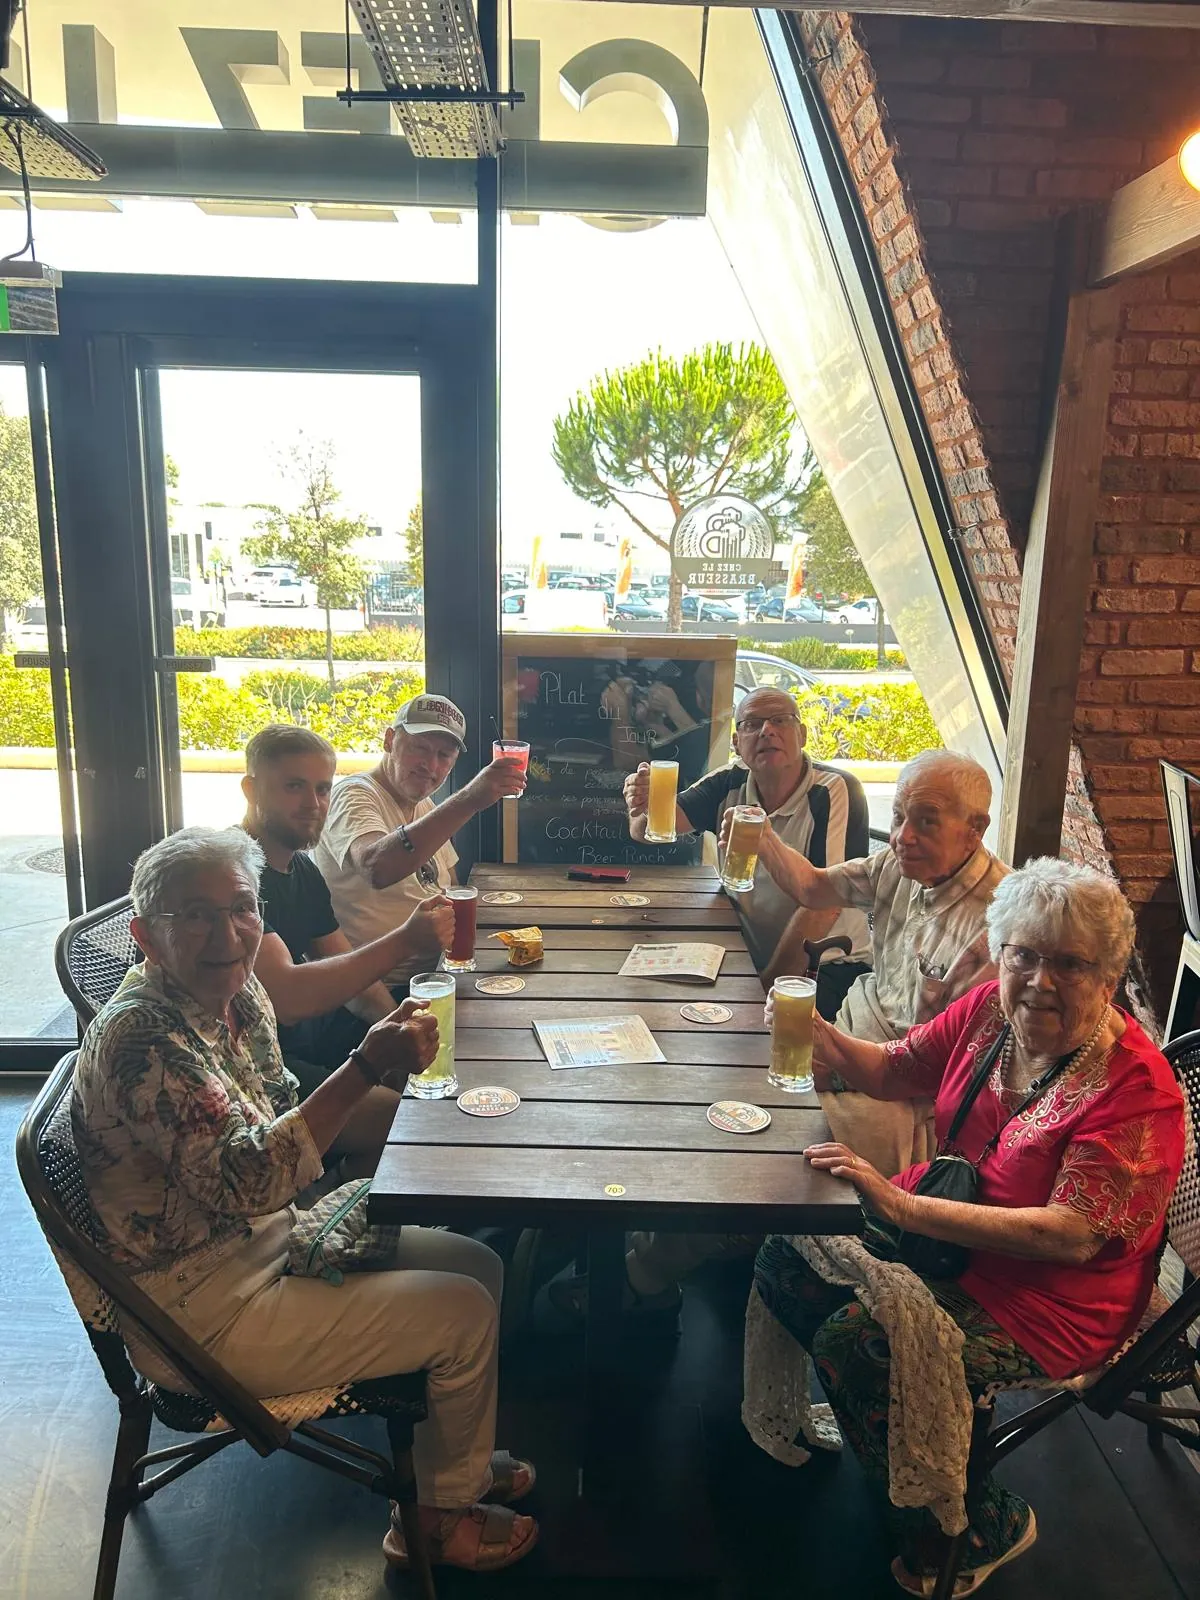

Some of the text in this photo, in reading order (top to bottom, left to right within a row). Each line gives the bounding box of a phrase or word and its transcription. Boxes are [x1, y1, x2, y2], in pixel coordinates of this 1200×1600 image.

[22, 656, 50, 666] POUSS
[598, 698, 621, 720] du
[545, 816, 622, 840] Cocktail
[607, 1186, 623, 1194] 703
